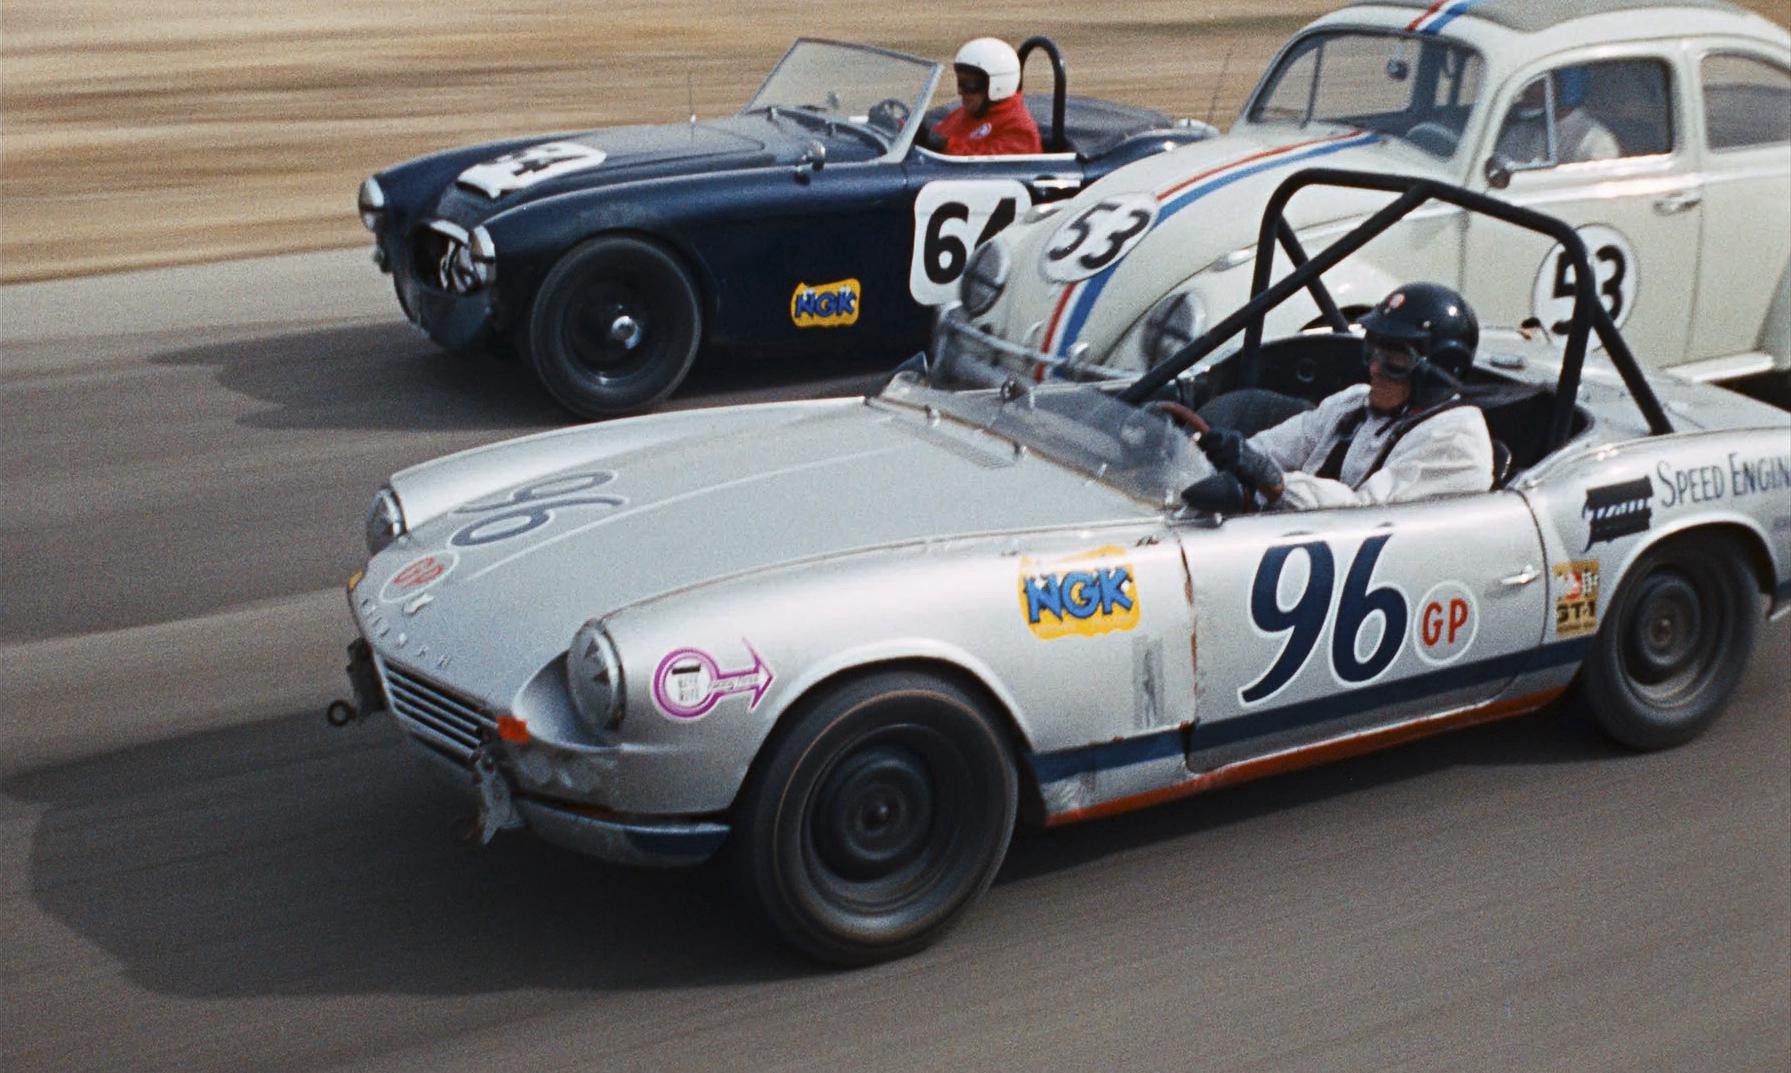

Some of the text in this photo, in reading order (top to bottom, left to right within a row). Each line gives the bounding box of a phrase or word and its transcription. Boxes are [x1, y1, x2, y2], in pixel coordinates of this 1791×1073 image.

[1048, 202, 1151, 269] 53
[795, 289, 857, 318] NGK
[450, 471, 625, 547] 96
[1657, 460, 1725, 507] SPEED
[1024, 566, 1134, 625] NGK
[1242, 534, 1408, 702] 96
[1422, 597, 1469, 647] GP
